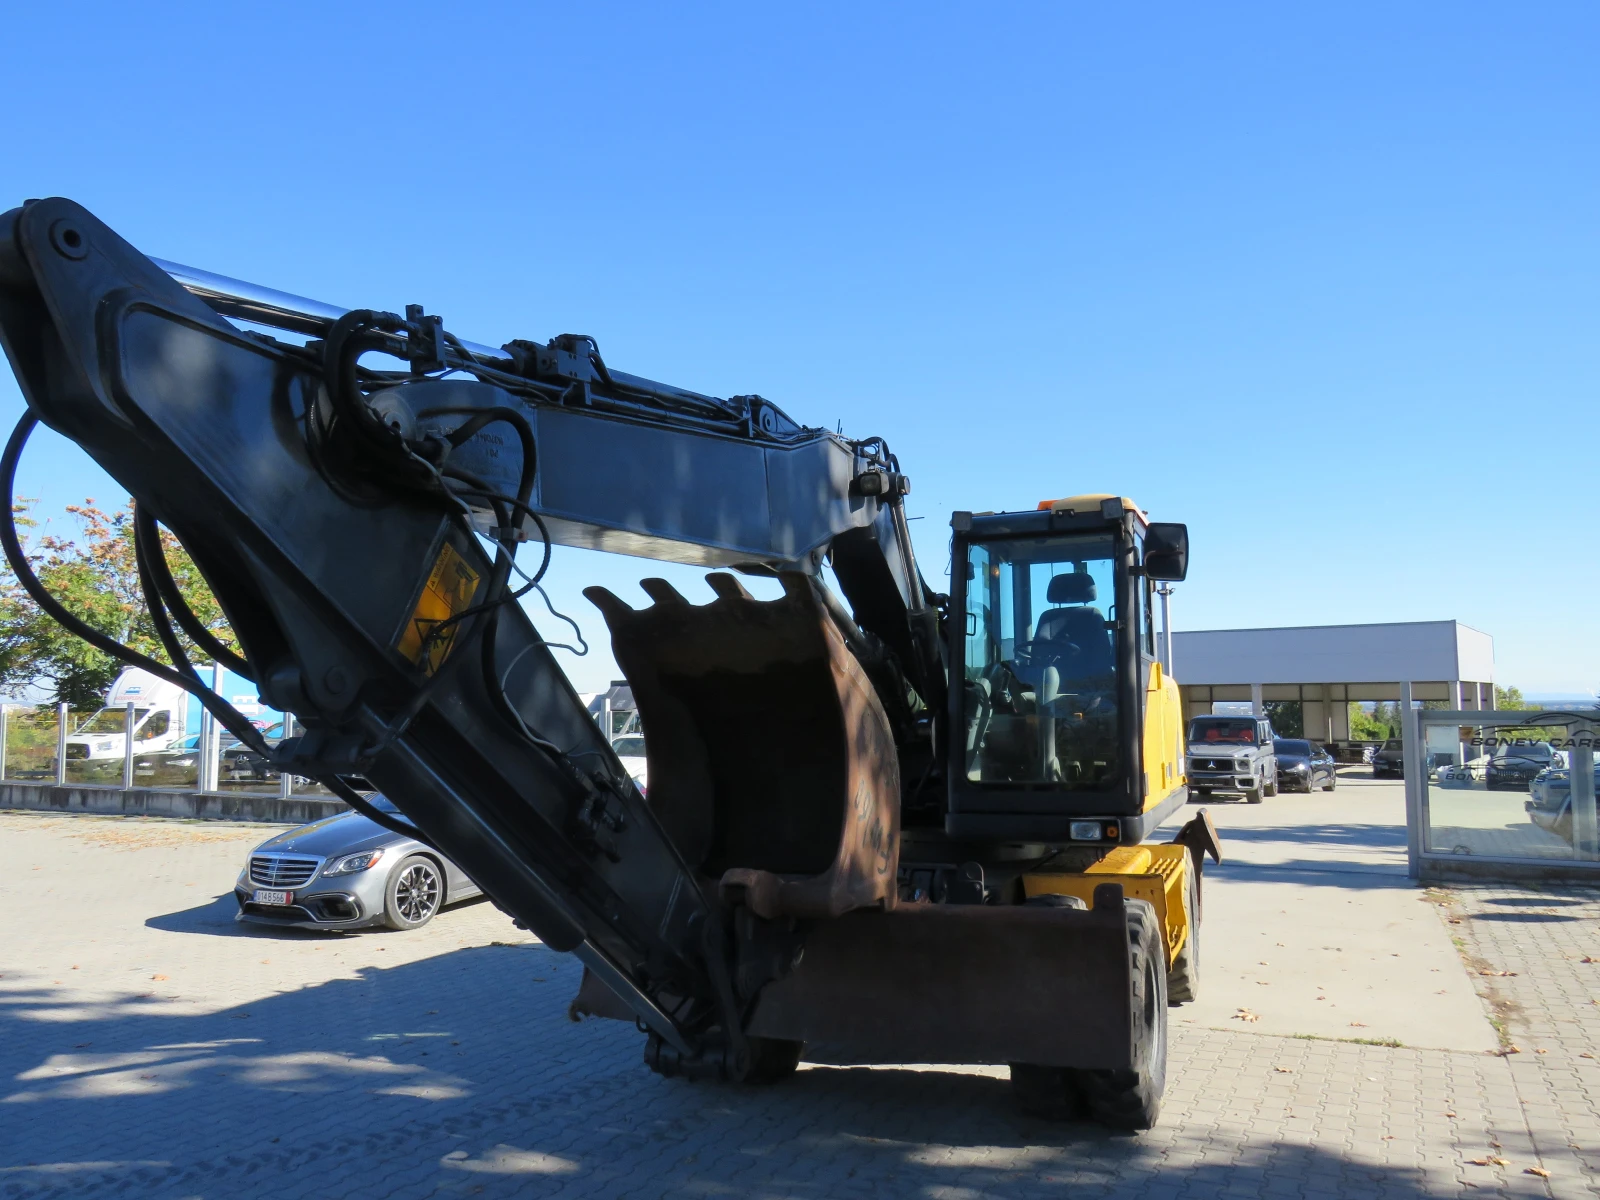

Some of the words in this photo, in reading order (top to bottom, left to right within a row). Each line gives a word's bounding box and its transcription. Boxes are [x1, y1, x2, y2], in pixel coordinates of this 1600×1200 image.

[1470, 737, 1542, 747] BONEV
[1549, 737, 1600, 748] CARS
[1445, 773, 1487, 781] BONE
